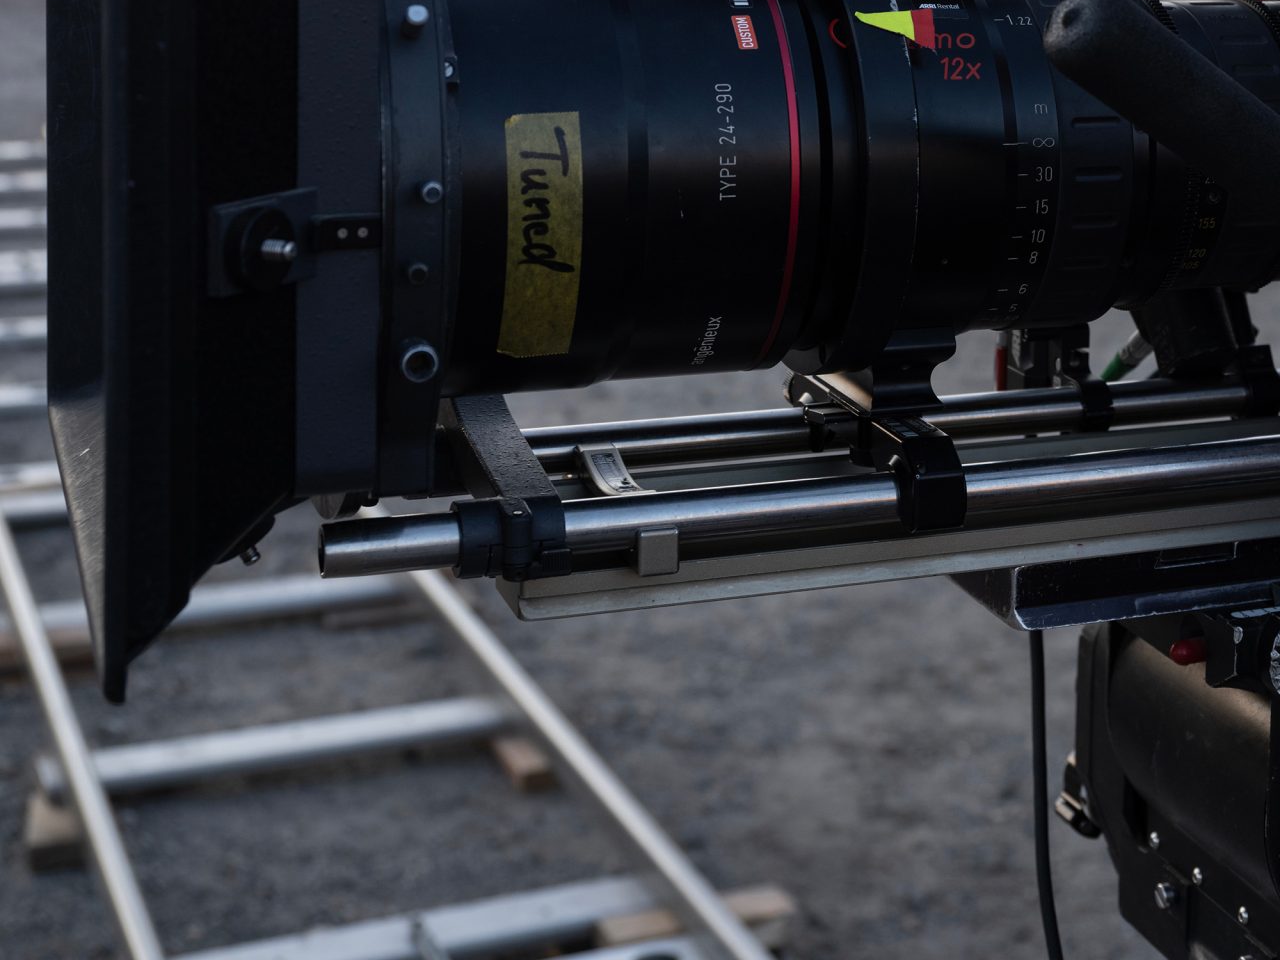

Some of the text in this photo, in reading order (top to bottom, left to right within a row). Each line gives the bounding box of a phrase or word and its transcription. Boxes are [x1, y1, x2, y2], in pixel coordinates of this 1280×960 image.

[1006, 14, 1033, 26] 1.22
[735, 16, 754, 48] CUSTOM
[940, 56, 982, 81] 12x
[714, 83, 737, 201] TYPE 24-290
[1035, 166, 1053, 183] 30
[517, 125, 575, 273] Tuned
[1034, 199, 1049, 215] 15
[1031, 229, 1046, 244] 10
[1028, 251, 1039, 265] 8
[1018, 283, 1028, 295] 6
